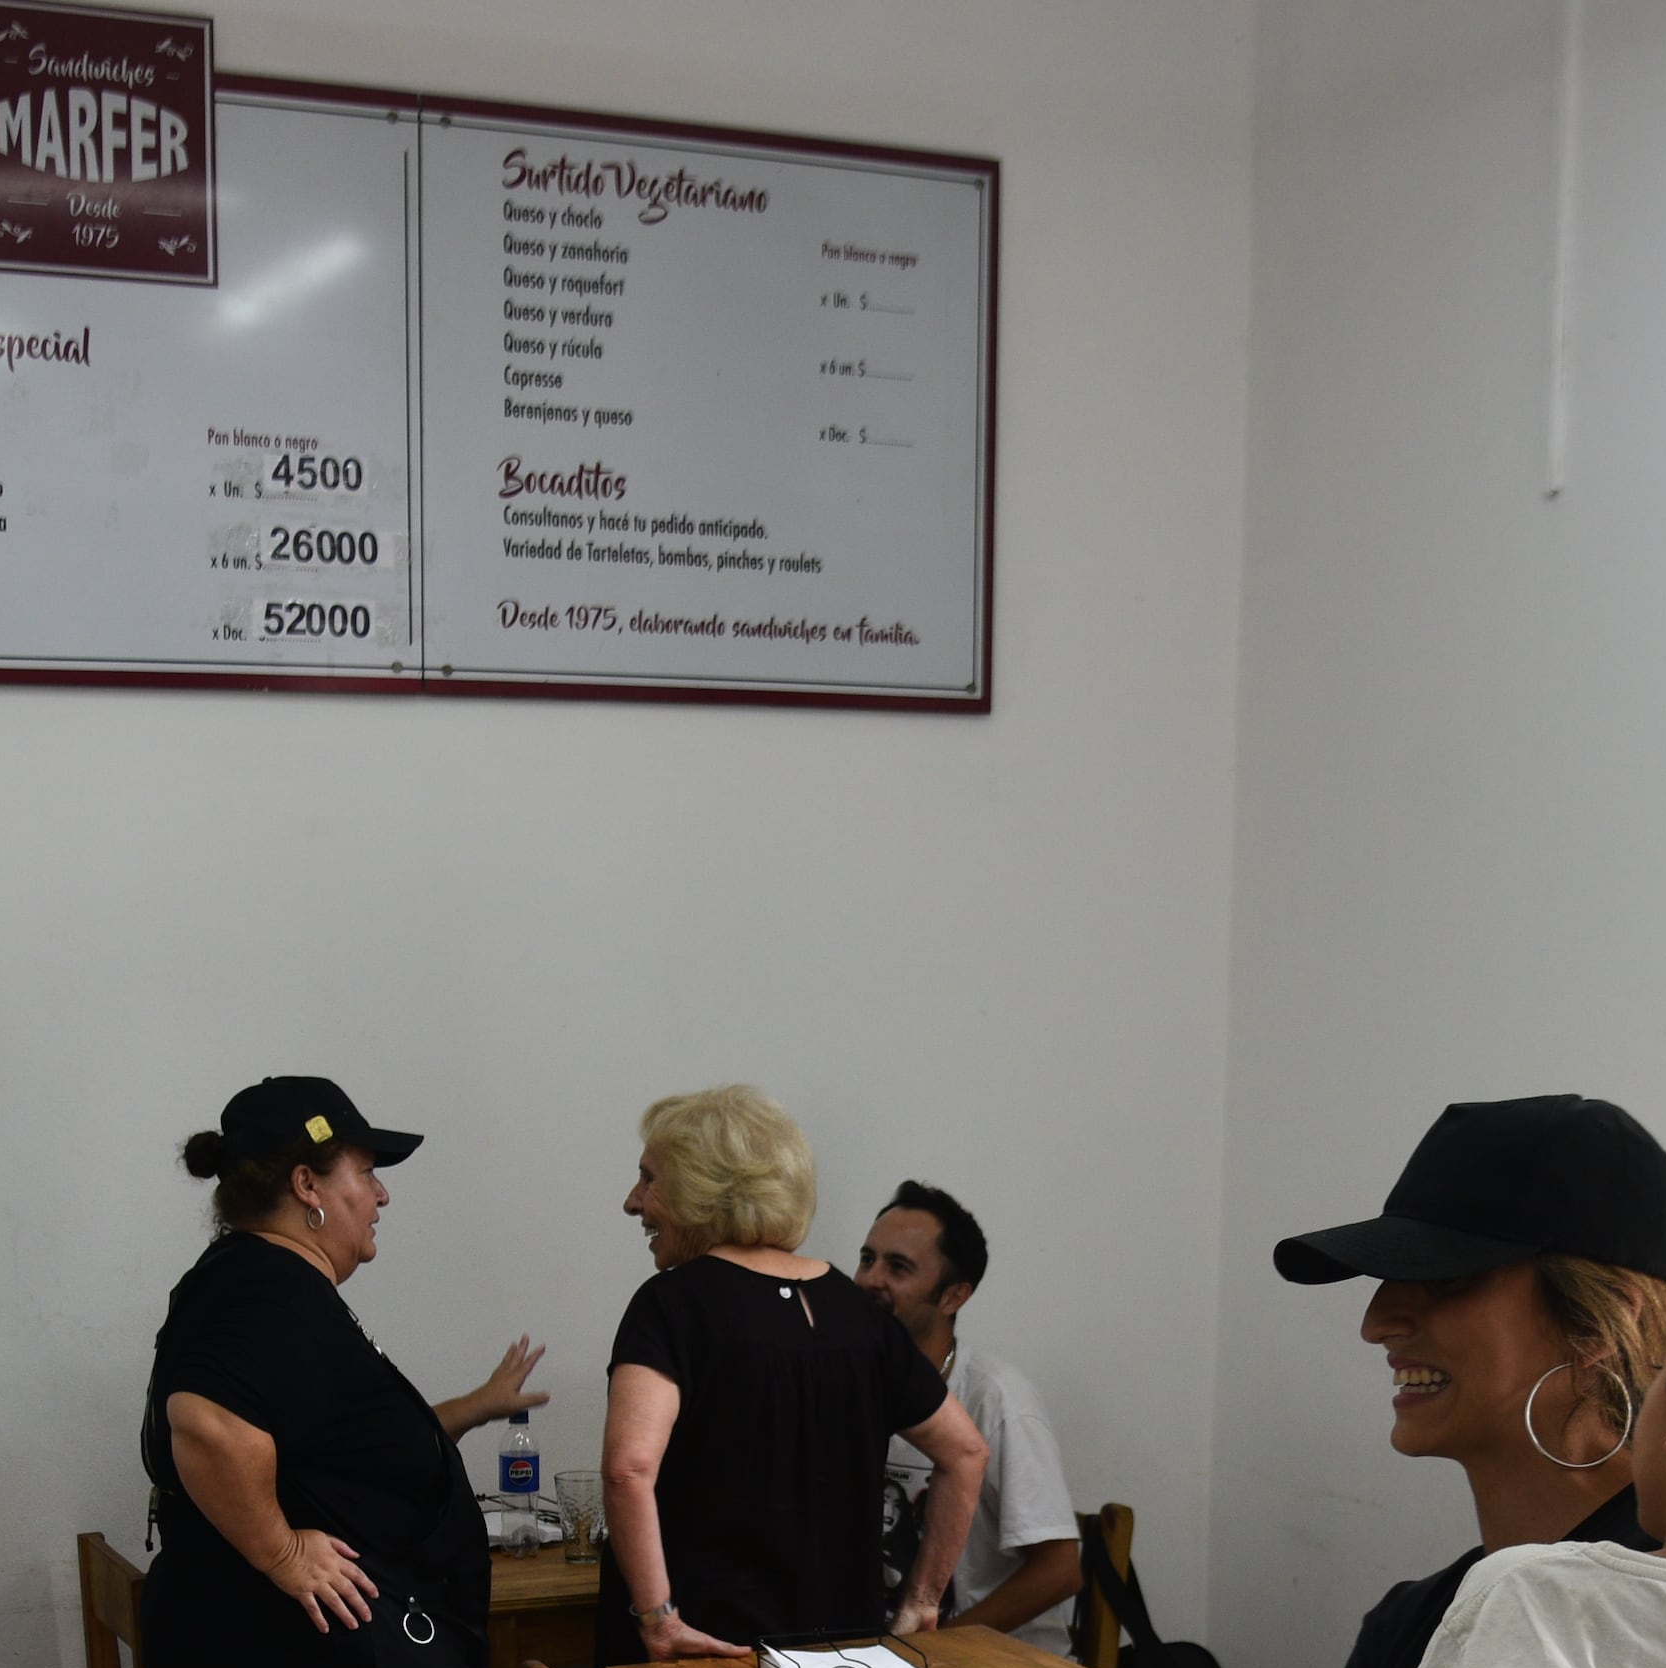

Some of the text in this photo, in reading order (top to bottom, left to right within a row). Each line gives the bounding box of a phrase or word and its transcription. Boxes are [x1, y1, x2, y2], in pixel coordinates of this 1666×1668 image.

[29, 43, 155, 88] Sandwiches
[502, 147, 768, 226] Surtido Vegetariano
[67, 192, 122, 220] Desde
[502, 199, 604, 230] Queso y choclo
[72, 223, 120, 250] 1975
[502, 232, 629, 265] Queso y zanahoria
[503, 265, 625, 298] Queso y roquefort
[503, 298, 614, 328] Queso y verdura
[503, 331, 604, 360] Queso y rúcula
[503, 363, 563, 391] Capresse
[503, 396, 634, 429] Berenjenas y queso
[207, 426, 319, 454] Pan blanco o negro
[271, 453, 363, 492] 4500
[497, 456, 627, 501] Bocaditos
[503, 504, 768, 542] Consultanos y hacé tu pedido anticipado.
[270, 526, 379, 565] 26000
[502, 537, 823, 575] Variedad de Tarteletas, bombas, pinches y roulets
[264, 601, 371, 639] 52000
[496, 600, 920, 646] Desde 1975, elaborando sandwiches en familia.
